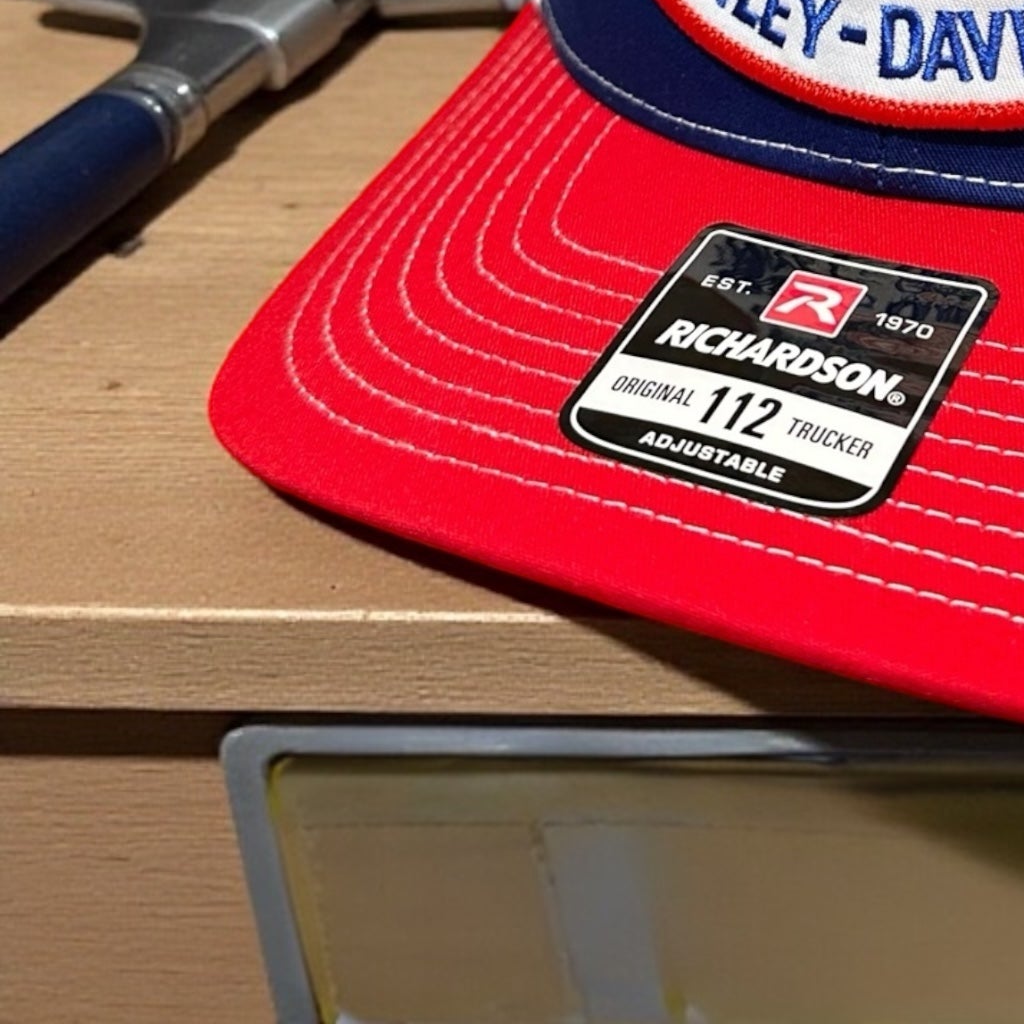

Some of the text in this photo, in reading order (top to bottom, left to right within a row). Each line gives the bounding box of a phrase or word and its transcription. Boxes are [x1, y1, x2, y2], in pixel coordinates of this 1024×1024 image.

[700, 274, 752, 295] EST.
[775, 280, 844, 325] R
[874, 311, 935, 340] 1970
[611, 375, 875, 460] ORIGINAL 112 TRUCKER
[638, 430, 786, 484] ADJUSTABLE
